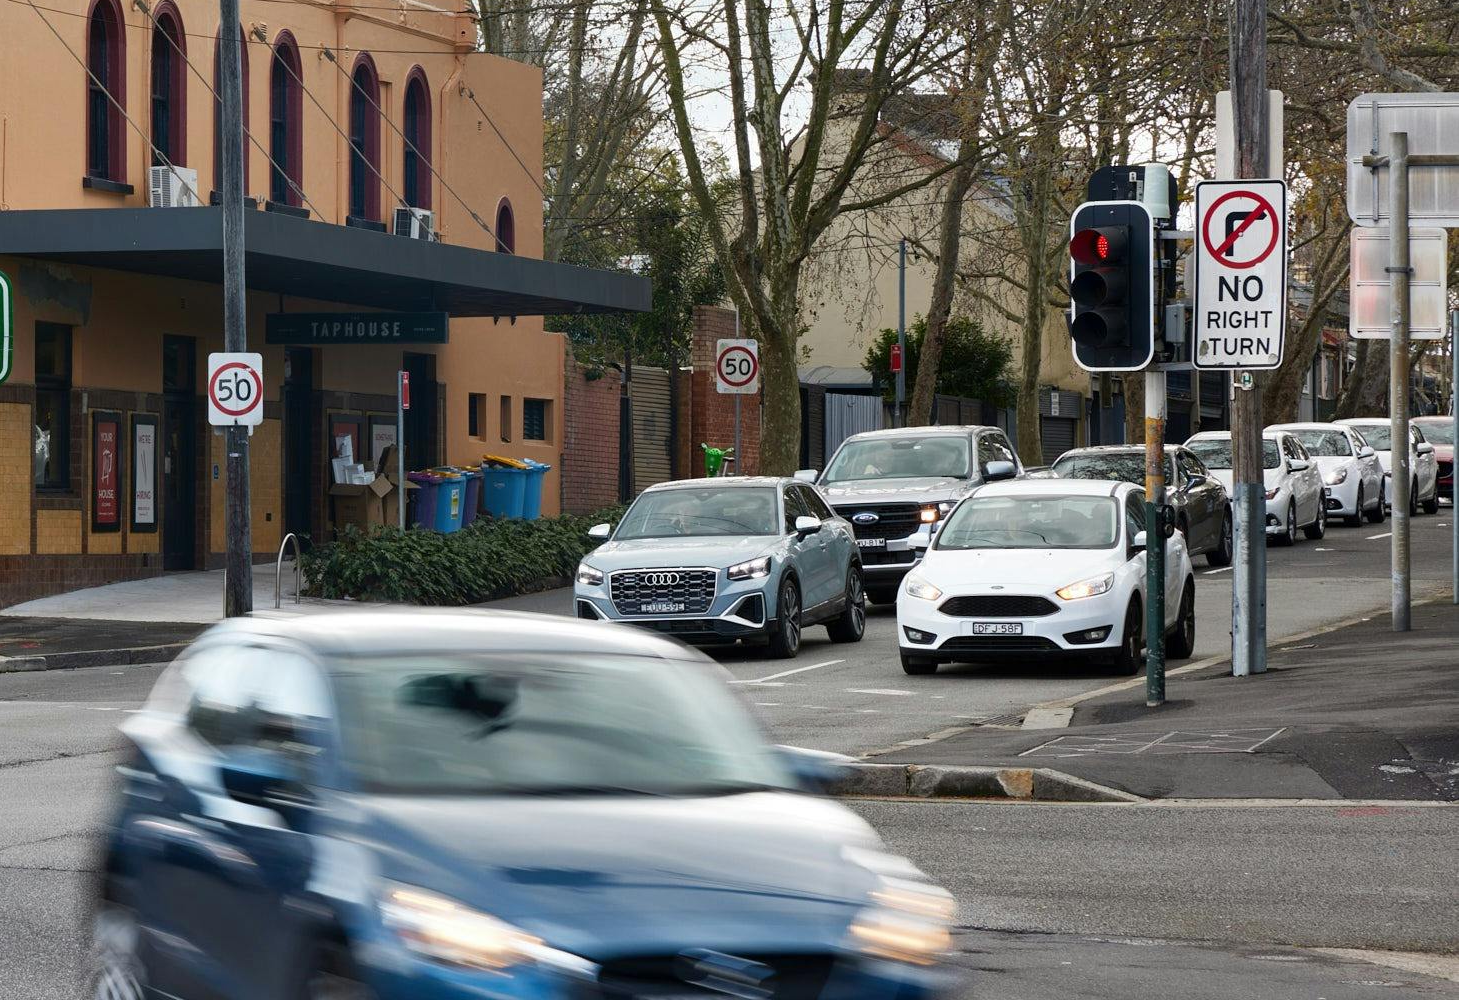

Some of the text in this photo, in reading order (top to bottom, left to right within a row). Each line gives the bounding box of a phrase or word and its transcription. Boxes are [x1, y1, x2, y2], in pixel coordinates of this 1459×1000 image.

[1218, 275, 1264, 302] NO
[311, 321, 401, 337] TAPHOUSE
[1207, 311, 1273, 329] RIGHT
[1208, 337, 1271, 356] TURN
[725, 358, 751, 376] 50
[218, 378, 252, 402] 50
[98, 489, 114, 499] HOUSE
